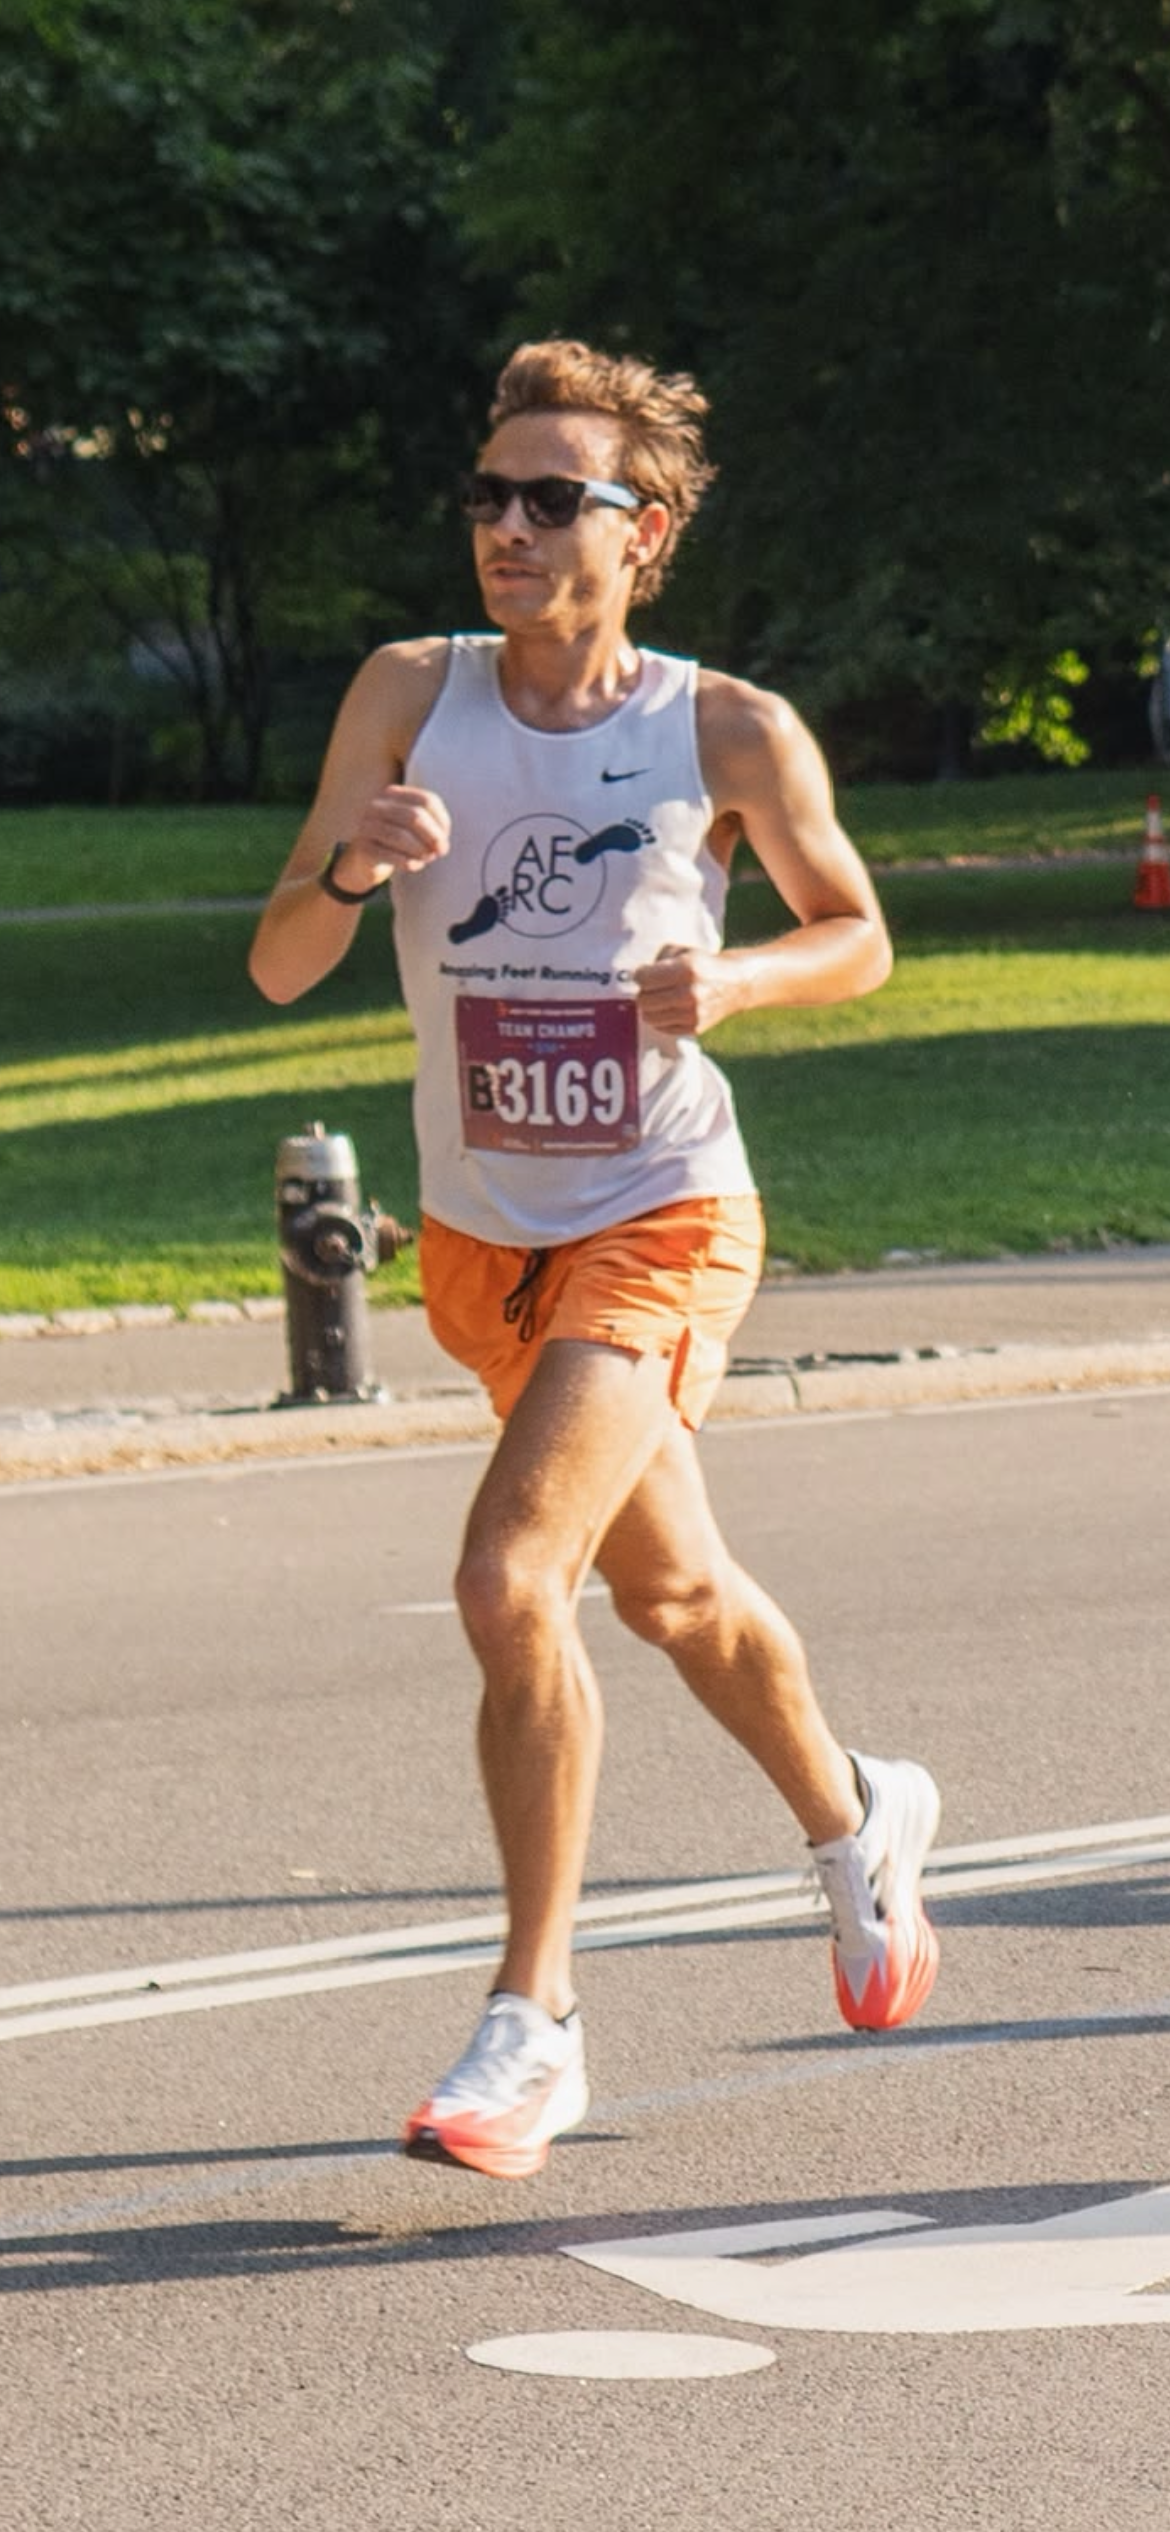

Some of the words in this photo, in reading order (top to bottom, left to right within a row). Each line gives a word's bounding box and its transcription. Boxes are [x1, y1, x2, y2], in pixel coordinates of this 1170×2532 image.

[512, 836, 572, 875] AF
[512, 874, 573, 915] RC
[501, 964, 536, 979] Feet
[541, 965, 610, 986] Running
[497, 1022, 533, 1037] TEAM
[538, 1023, 596, 1038] CHAMPS
